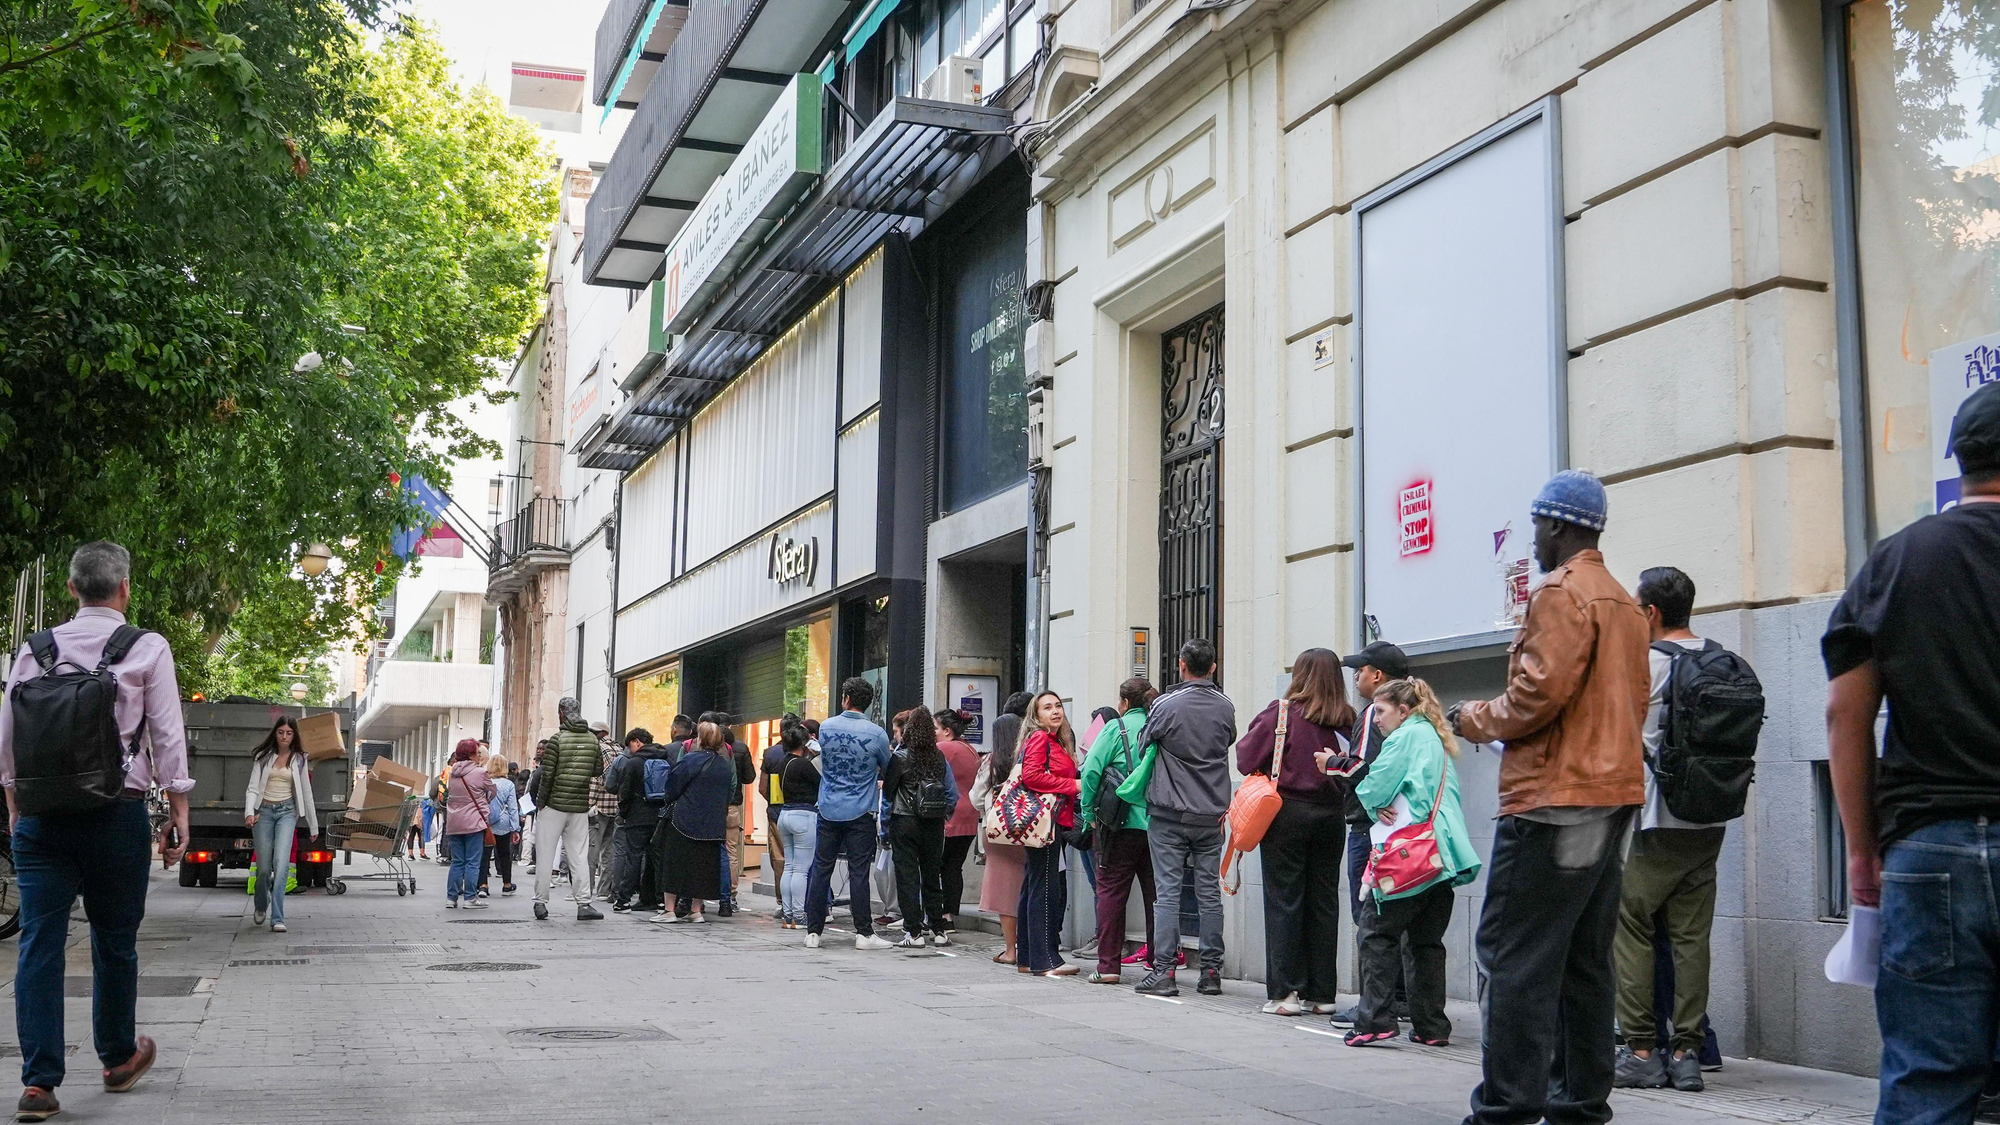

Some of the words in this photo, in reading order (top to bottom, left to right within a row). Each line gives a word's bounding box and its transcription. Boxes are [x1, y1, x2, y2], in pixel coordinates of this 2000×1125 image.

[682, 203, 720, 275] AVILÉS
[724, 187, 733, 218] &
[737, 108, 789, 202] IBÁÑEZ
[710, 207, 748, 263] CONSULTORES
[749, 195, 758, 214] DE
[759, 159, 788, 202] EMPRESA
[971, 326, 986, 353] SHOP
[1209, 390, 1221, 429] 2
[1402, 499, 1427, 516] CRIMINAL
[1403, 487, 1426, 502] ISRAEL
[1404, 518, 1428, 537] STOP
